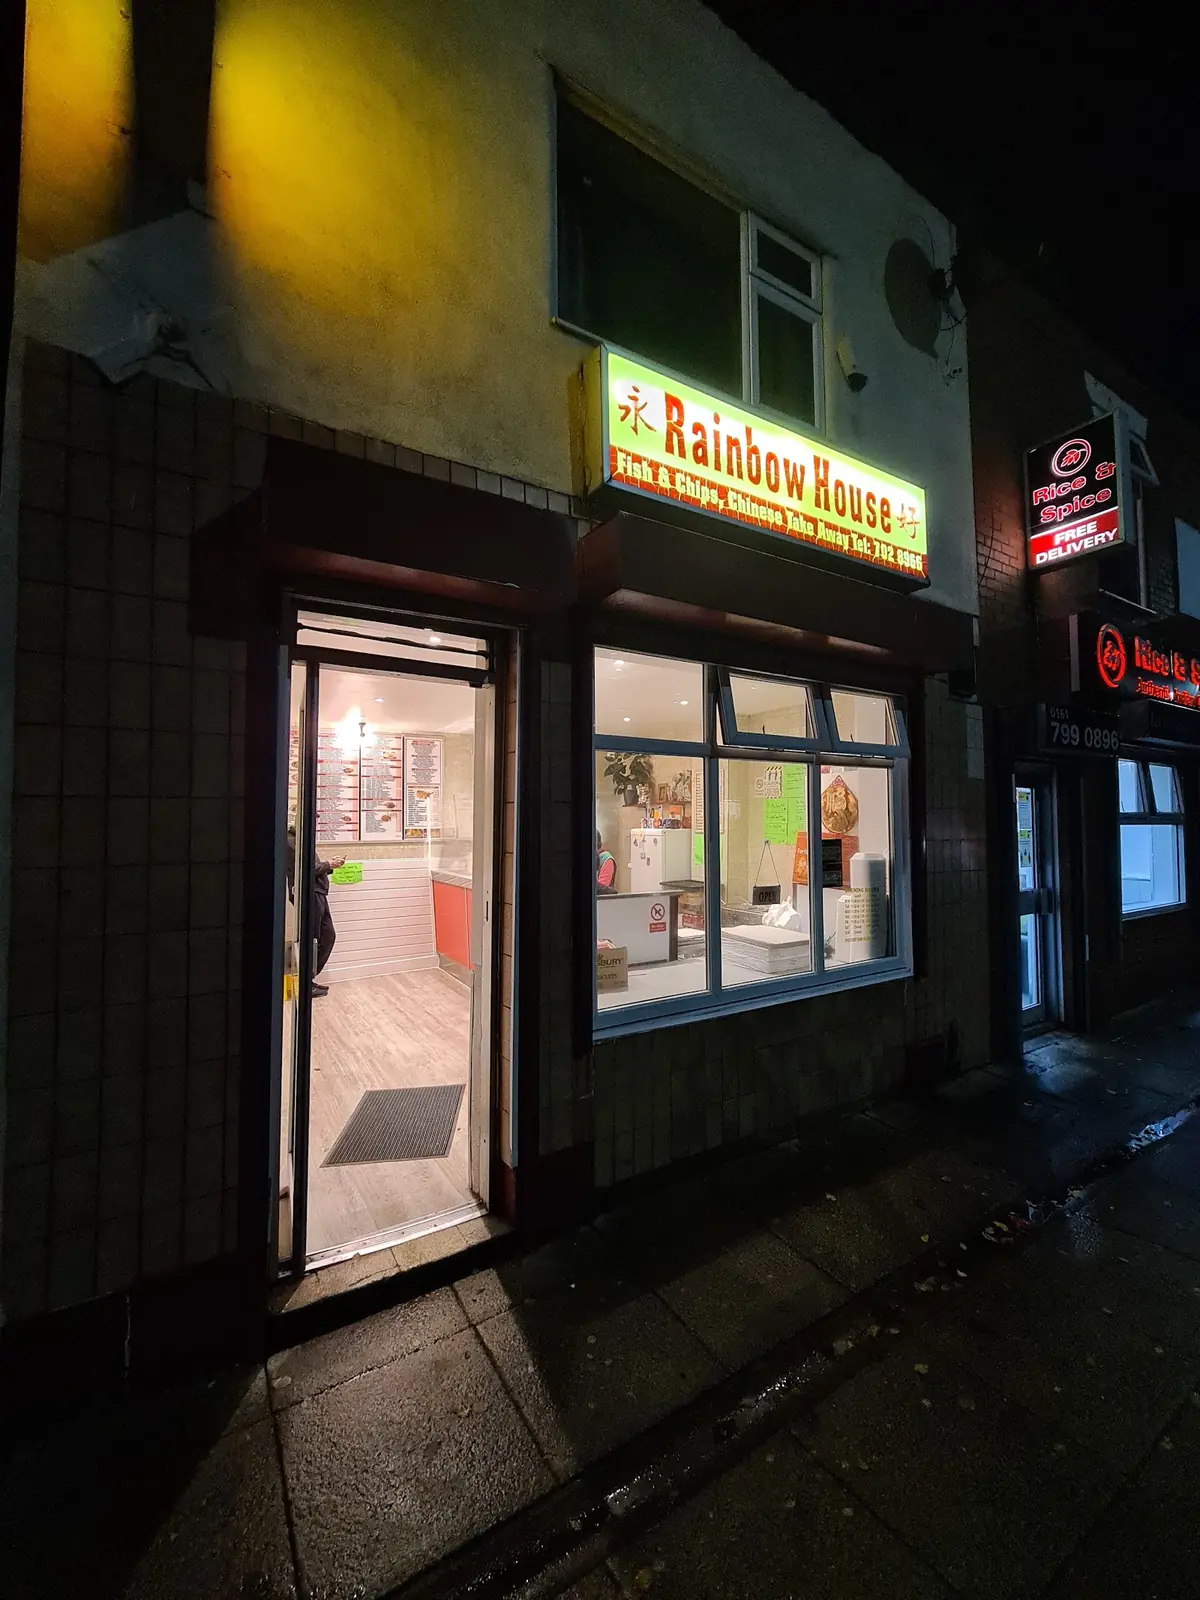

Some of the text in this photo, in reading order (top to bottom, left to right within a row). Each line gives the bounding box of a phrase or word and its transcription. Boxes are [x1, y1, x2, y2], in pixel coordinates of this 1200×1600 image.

[618, 385, 656, 436] 永
[664, 391, 893, 534] Rainbow House
[1032, 461, 1117, 505] Rice &
[616, 450, 653, 481] Fish
[658, 467, 671, 488] &
[675, 472, 724, 510] Chips,
[727, 490, 784, 526] Chinese
[786, 508, 815, 536] Take
[817, 519, 850, 553] Away
[851, 532, 871, 555] Tel:
[897, 548, 923, 572] 8966
[896, 502, 920, 540] 好
[1040, 488, 1112, 523] Spice
[1035, 527, 1118, 565] DELIVERY
[1053, 520, 1098, 546] FREE
[1050, 706, 1069, 720] 0161
[1050, 721, 1120, 751] 799 0896
